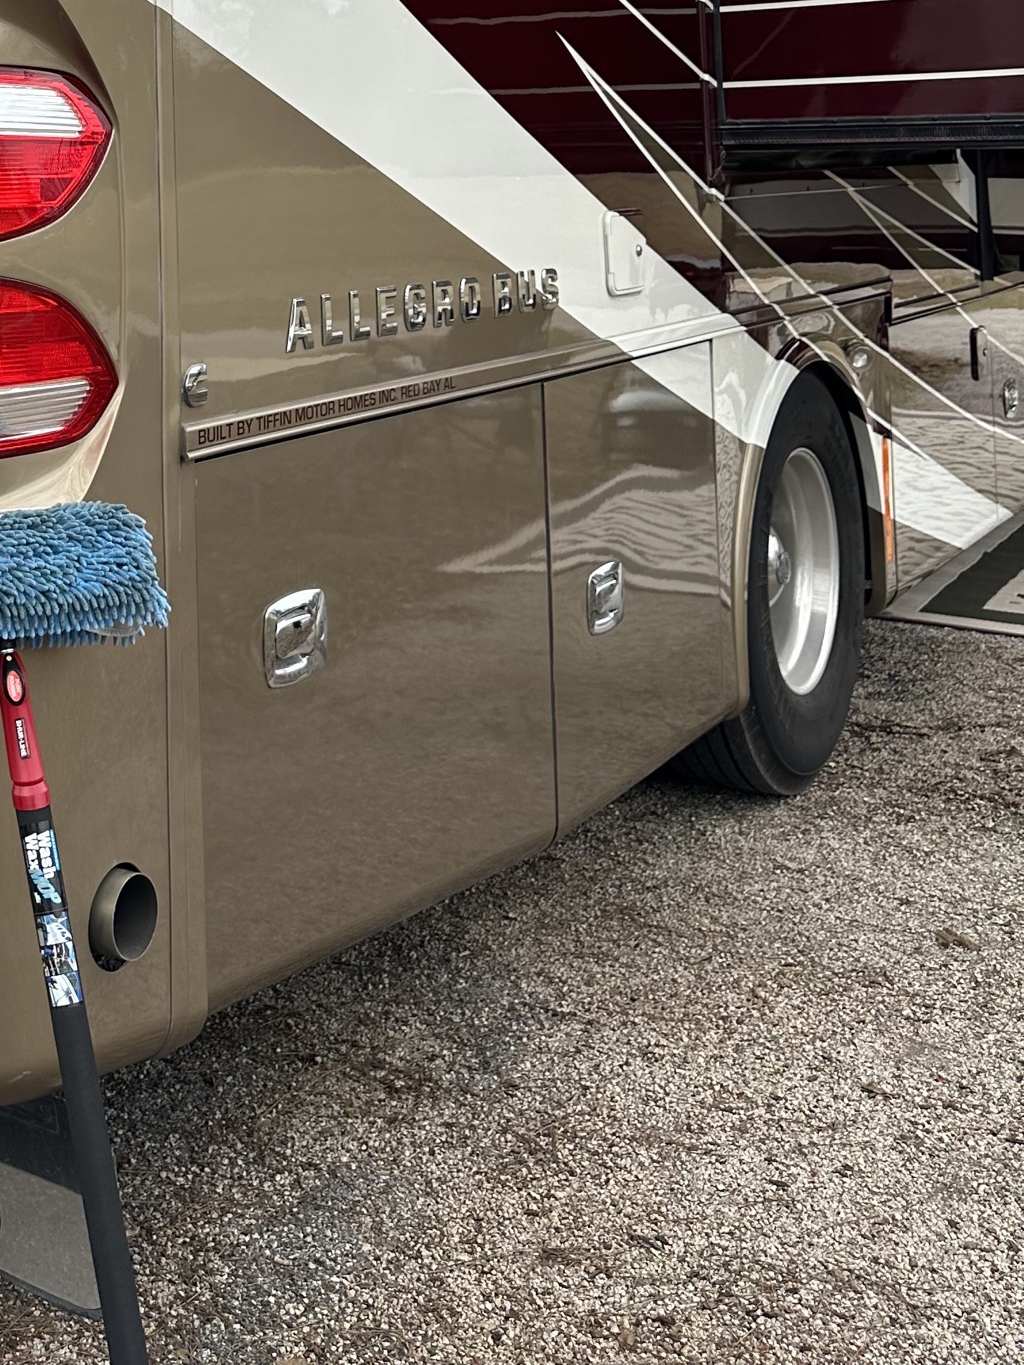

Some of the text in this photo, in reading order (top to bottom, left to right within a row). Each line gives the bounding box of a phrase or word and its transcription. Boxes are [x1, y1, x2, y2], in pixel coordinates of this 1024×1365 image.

[285, 268, 560, 353] ALLEGRO BUS
[198, 422, 234, 445] BUILT
[237, 418, 254, 437] BY
[256, 410, 292, 432] TIFFIN
[295, 401, 336, 423] MOTOR
[338, 392, 376, 413] HOMES
[401, 383, 420, 400] RED
[423, 378, 442, 395] BAY
[24, 832, 39, 870] Wax
[37, 830, 56, 879] Wash
